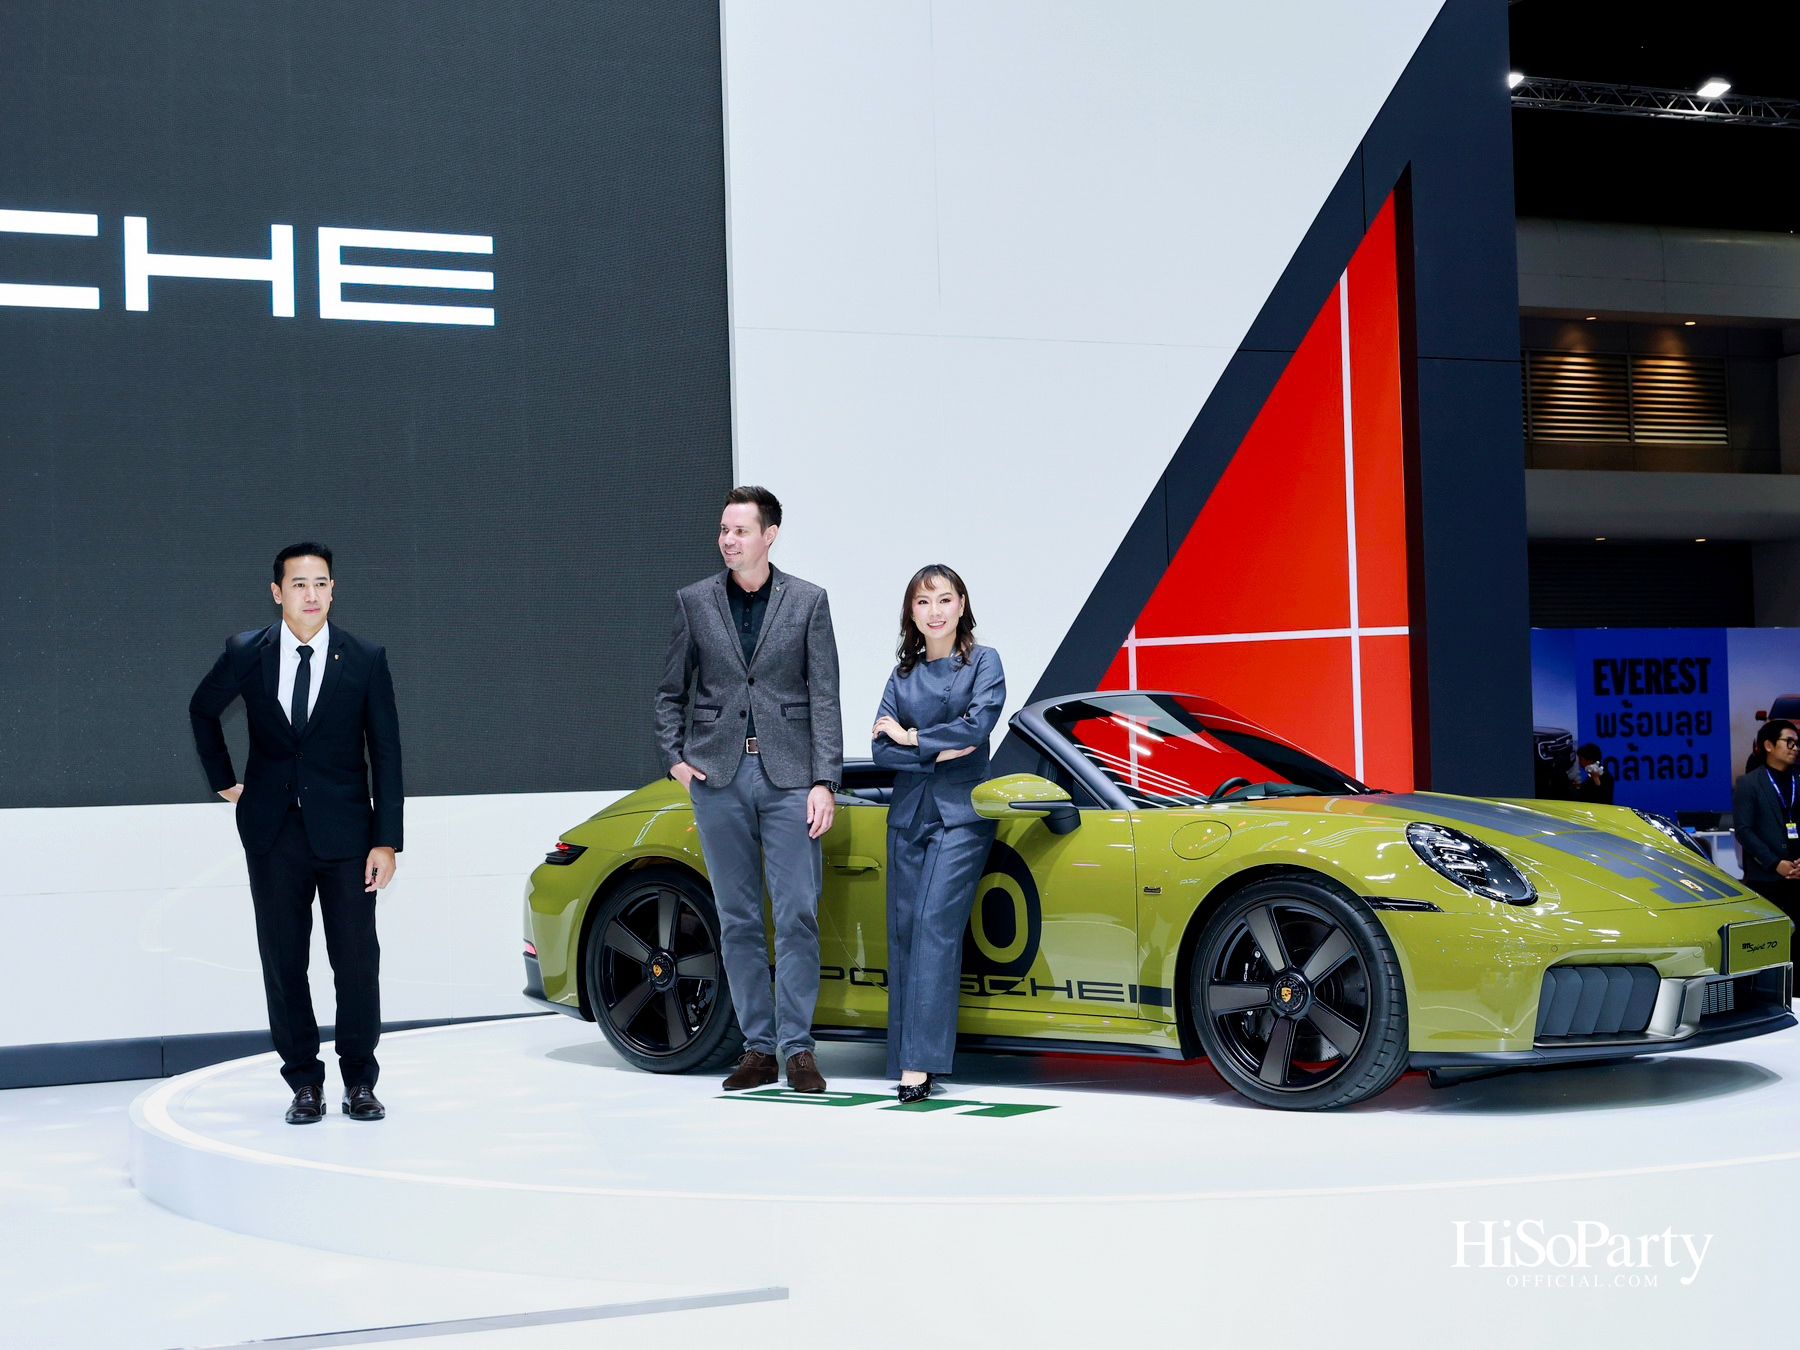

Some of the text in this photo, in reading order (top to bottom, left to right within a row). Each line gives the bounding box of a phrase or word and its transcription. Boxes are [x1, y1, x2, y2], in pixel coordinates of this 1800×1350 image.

[1593, 657, 1711, 696] EVEREST
[1595, 699, 1712, 748] พร้อมลุย
[1767, 941, 1777, 949] 70
